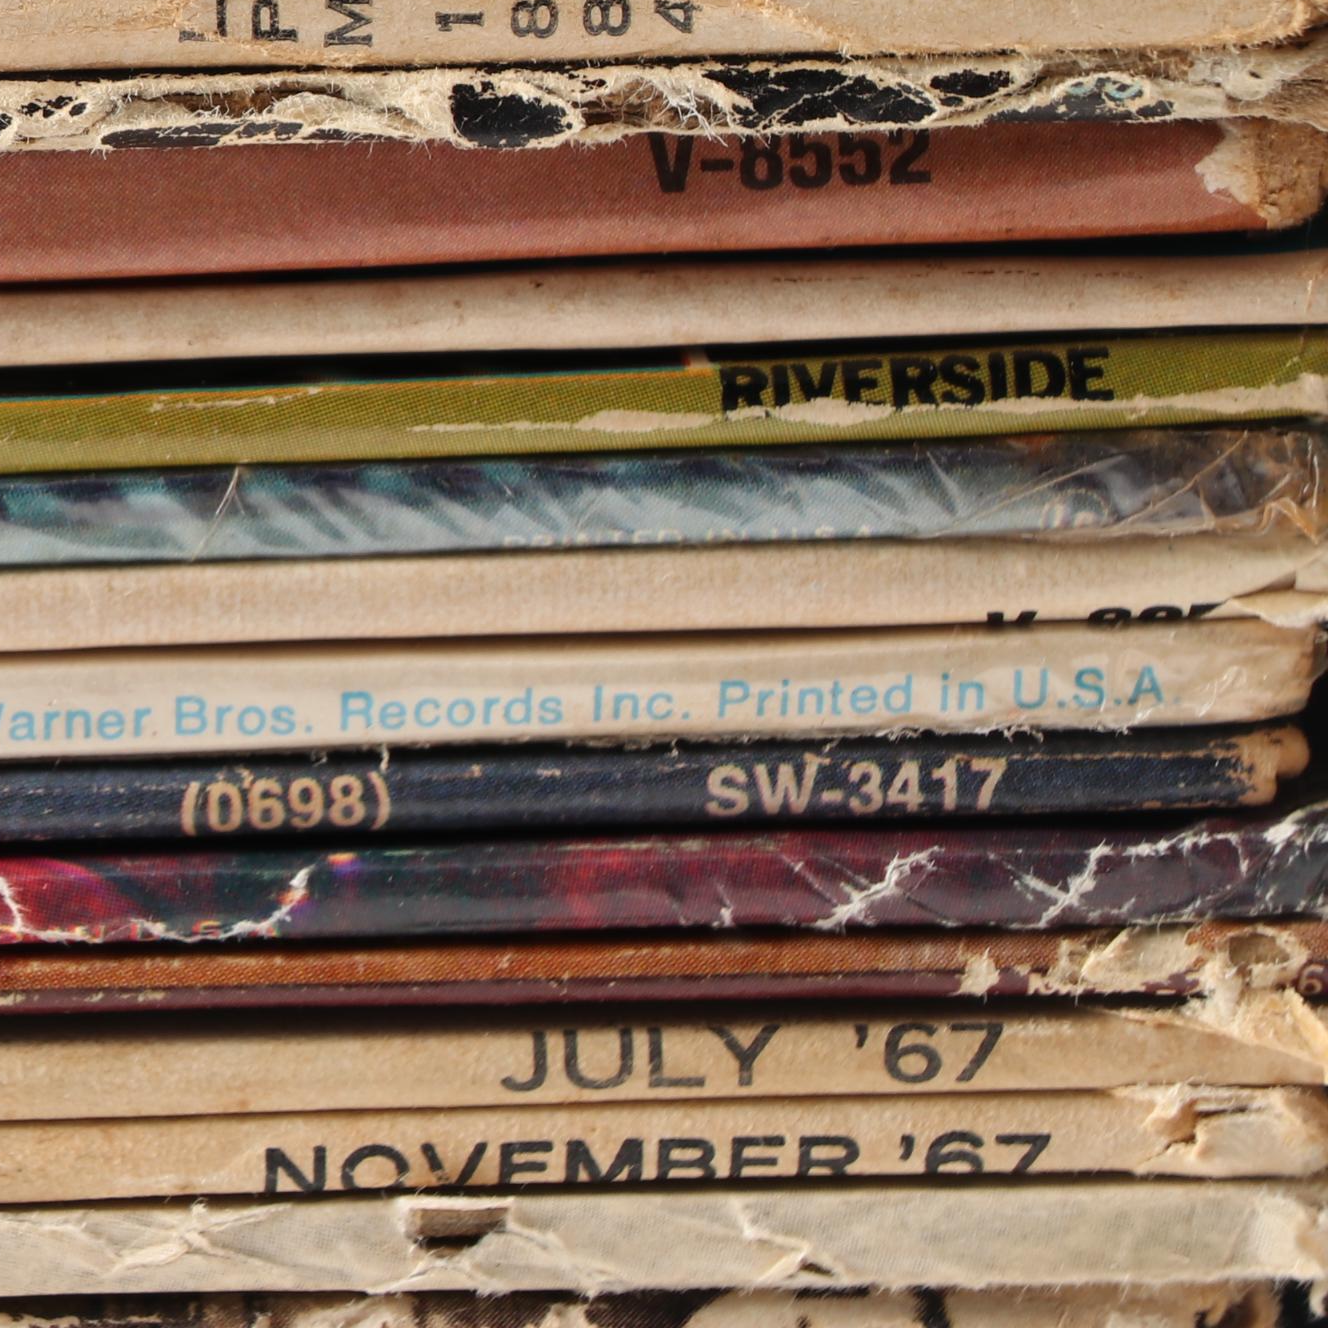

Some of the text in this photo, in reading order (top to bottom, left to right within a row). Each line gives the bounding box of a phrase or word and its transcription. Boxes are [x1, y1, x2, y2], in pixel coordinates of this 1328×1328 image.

[648, 127, 933, 193] V-8552
[720, 345, 1115, 414] RIVERSIDE
[174, 694, 314, 736] Bros.
[339, 685, 564, 732] Records
[592, 683, 692, 722] Inc.
[717, 673, 913, 718] Printed
[940, 671, 986, 711] in
[181, 756, 1009, 837] (0698) SW-3417
[500, 1021, 1006, 1093] JULY '67
[263, 1130, 1052, 1194] NOVEMBER '67
